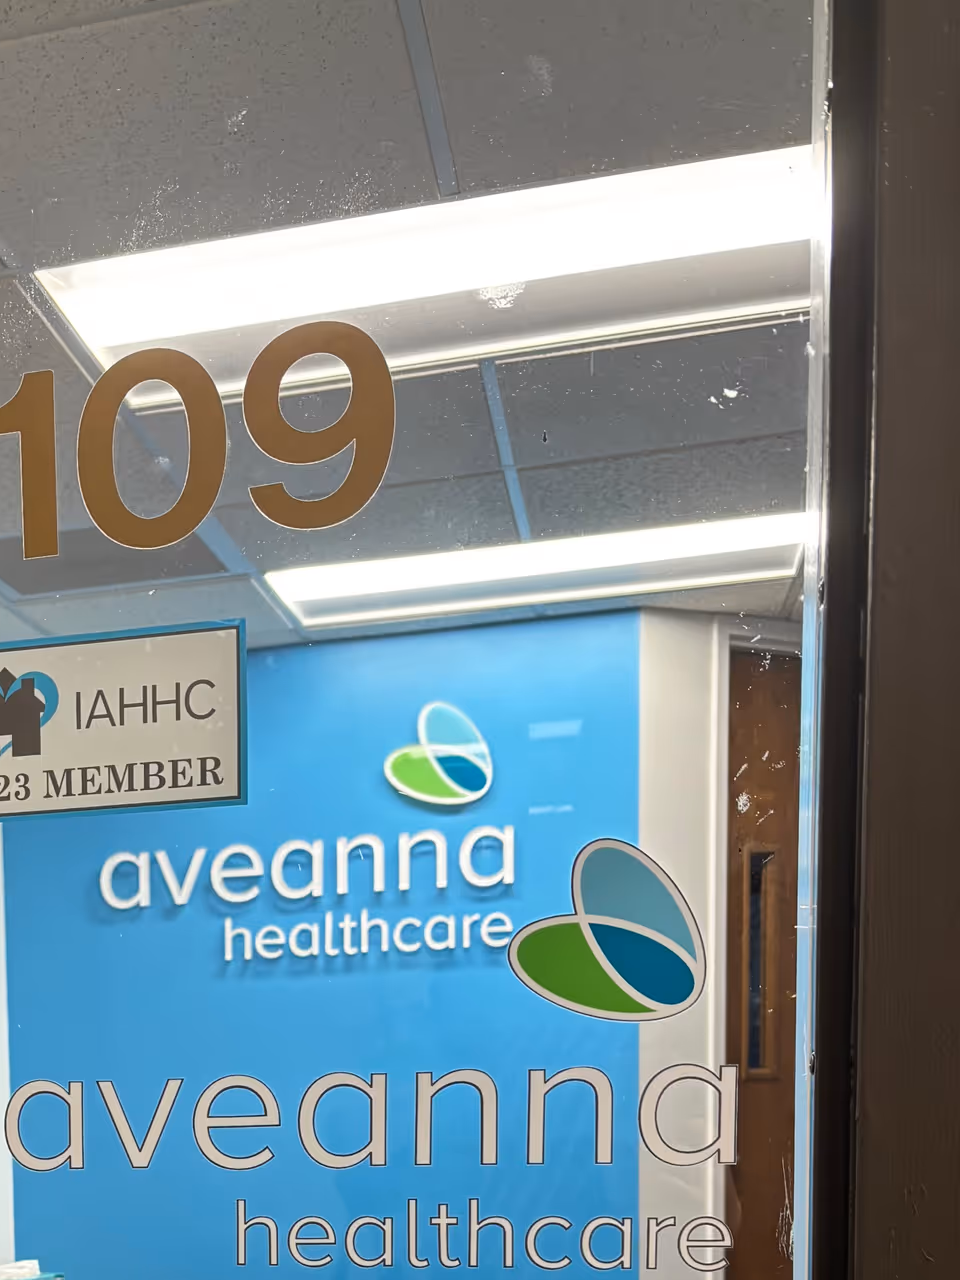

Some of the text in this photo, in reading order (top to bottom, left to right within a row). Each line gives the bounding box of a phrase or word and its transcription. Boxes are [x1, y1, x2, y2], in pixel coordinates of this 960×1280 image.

[74, 679, 217, 731] IAHHC
[42, 756, 225, 800] MEMBER
[99, 825, 515, 910] aveanna
[223, 908, 514, 962] healthcare
[4, 1063, 740, 1172] aveanna
[235, 1198, 734, 1272] healthcare
